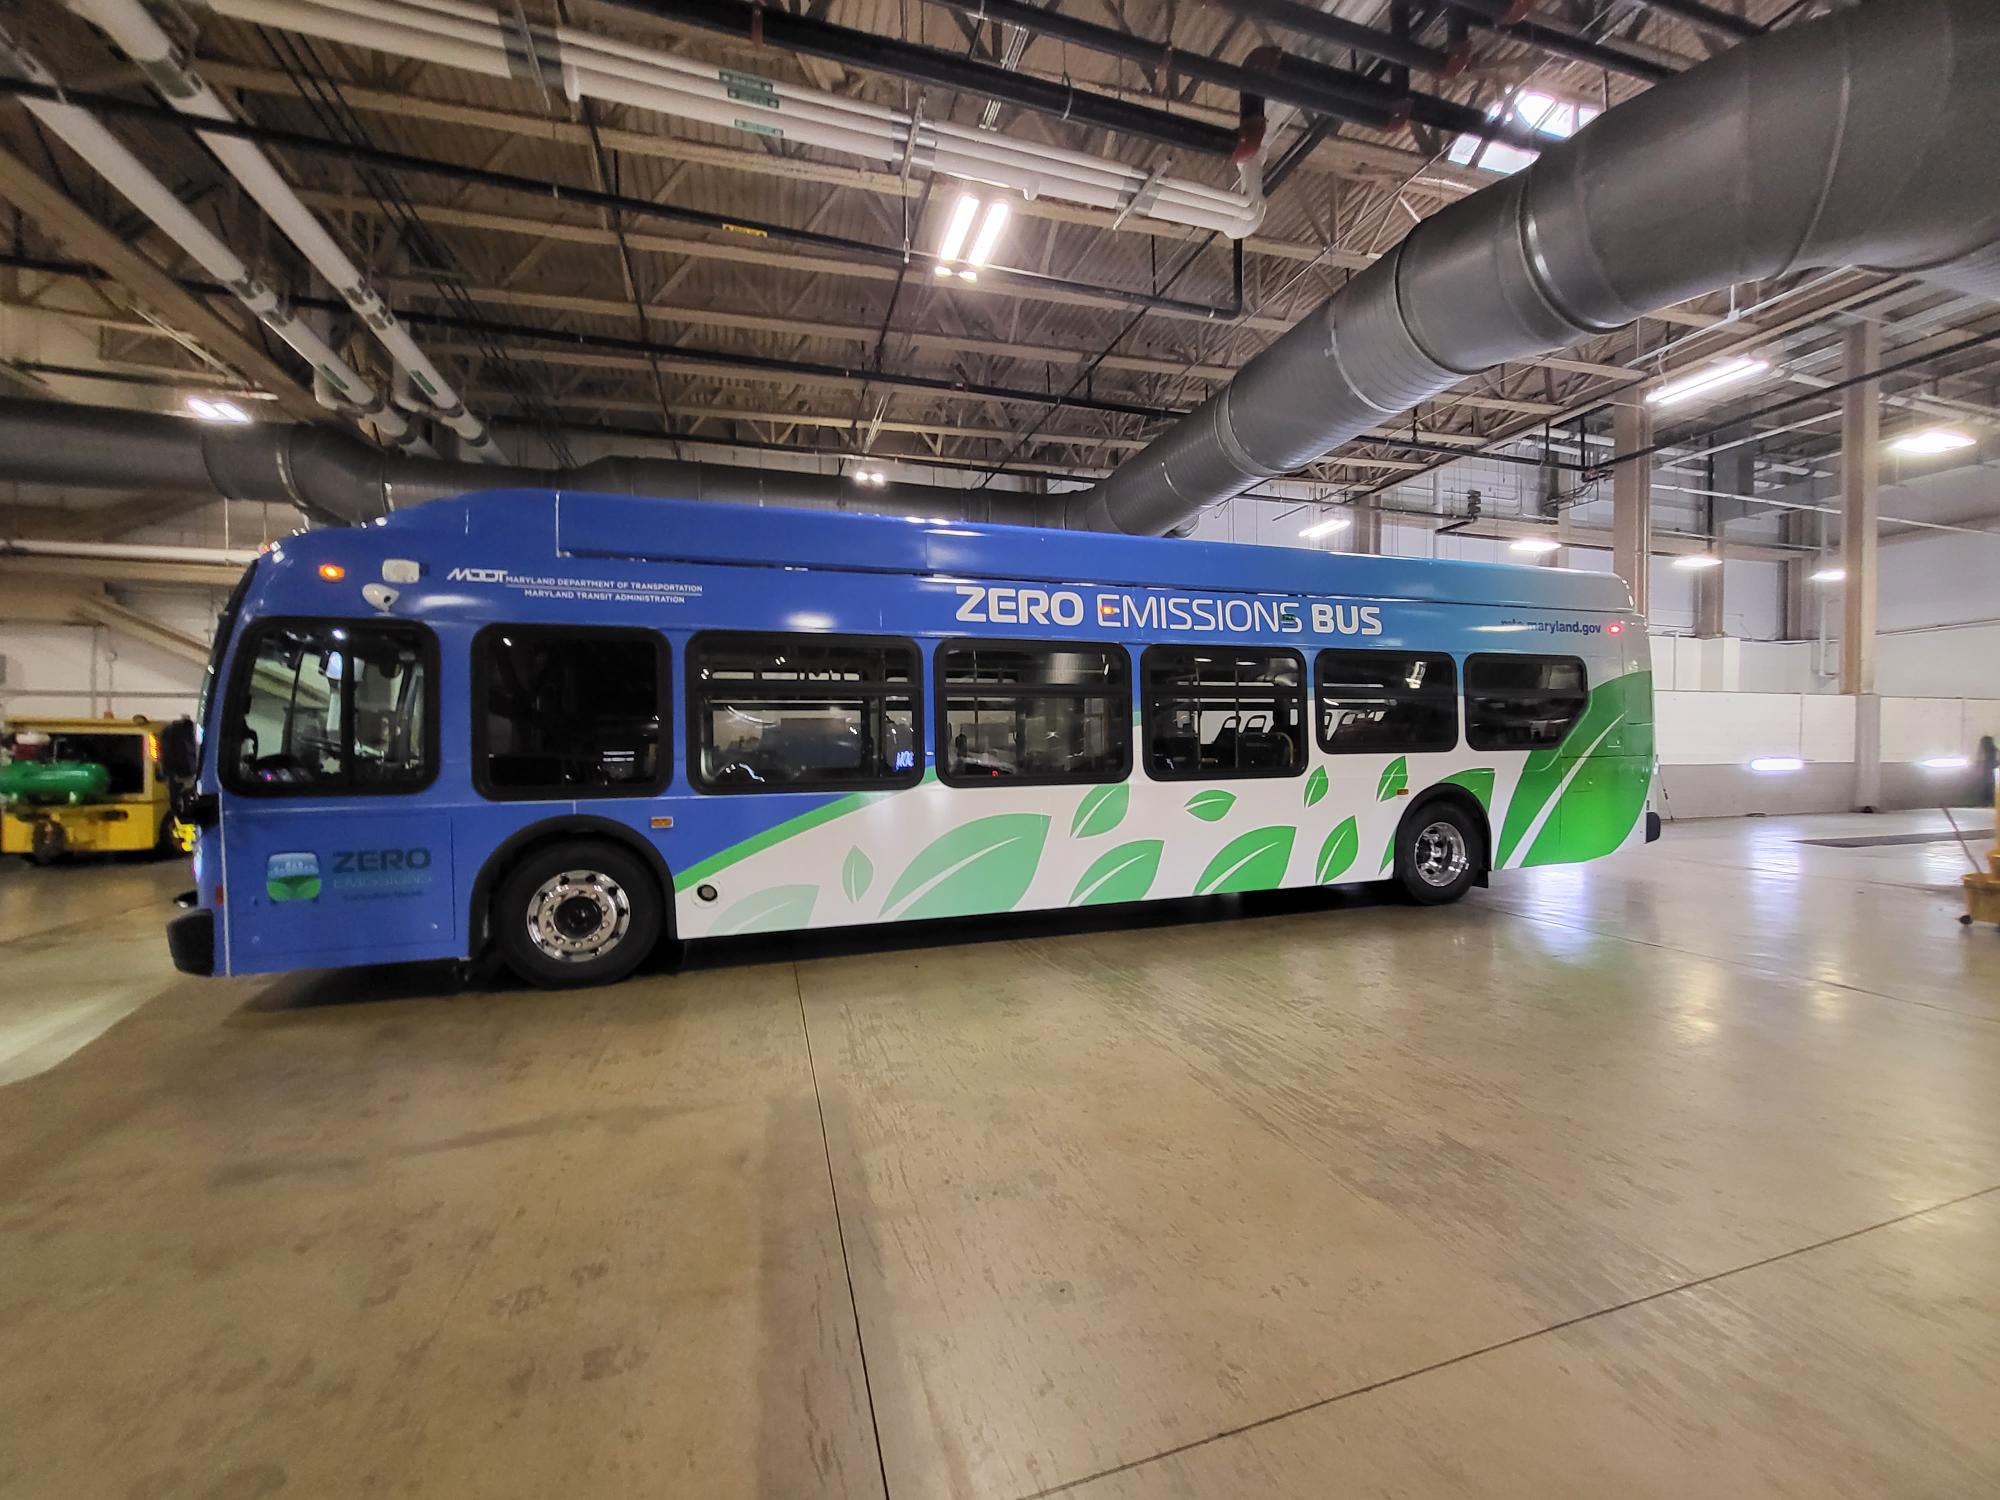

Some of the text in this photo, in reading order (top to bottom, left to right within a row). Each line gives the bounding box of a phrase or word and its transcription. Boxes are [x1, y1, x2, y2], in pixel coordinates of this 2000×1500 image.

[446, 568, 508, 583] MDOT
[505, 575, 703, 593] MARYLAND DEPARTMENT OF TRANSPORTATION
[524, 589, 685, 604] MARYLAND TRANSIT ADMINISTRATION
[955, 586, 1383, 636] ZERO EMISSIONS BUS
[1501, 619, 1601, 636] maryland.gov
[332, 847, 432, 874] ZERO
